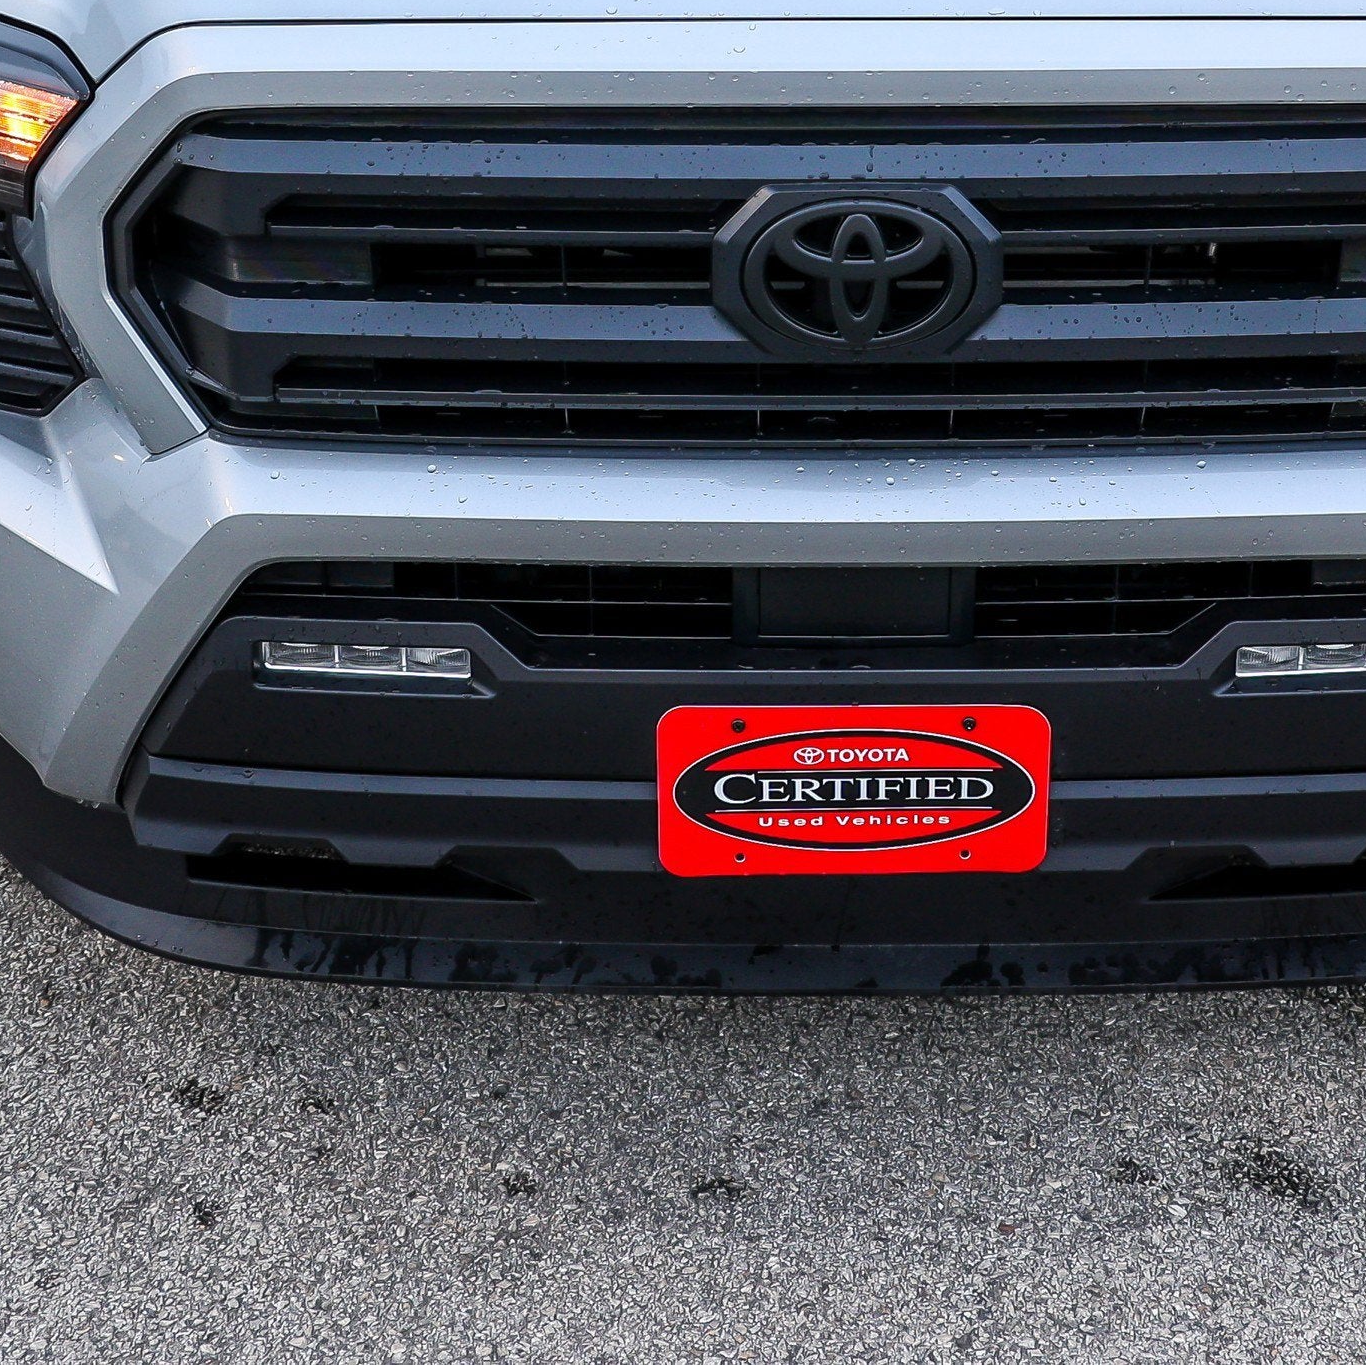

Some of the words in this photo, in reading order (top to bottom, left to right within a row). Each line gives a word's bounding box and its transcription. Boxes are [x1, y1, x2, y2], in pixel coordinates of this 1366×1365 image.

[826, 747, 910, 763] TOYOTA
[713, 773, 995, 805] CERTIFIED
[757, 815, 824, 828] Used
[835, 814, 951, 827] Vehicles
